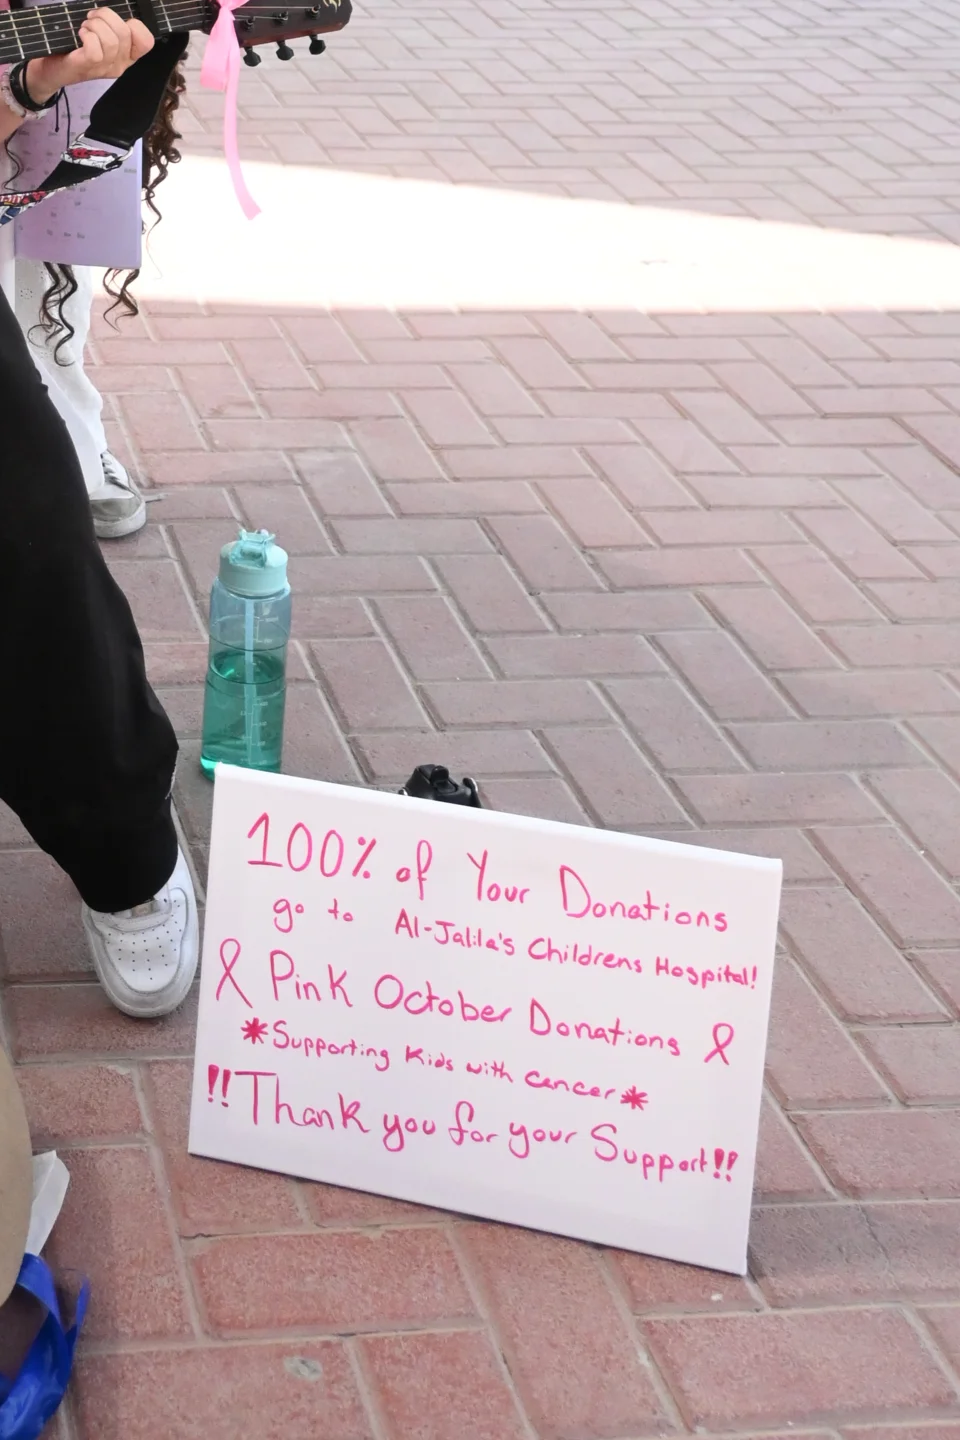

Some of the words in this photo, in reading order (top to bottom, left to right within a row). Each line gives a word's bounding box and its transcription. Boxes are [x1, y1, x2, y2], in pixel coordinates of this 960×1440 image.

[246, 812, 376, 880] 100%
[396, 839, 433, 900] of
[467, 849, 530, 903] Your
[559, 864, 729, 933] Donations
[272, 898, 304, 934] go
[327, 897, 354, 922] to
[394, 908, 515, 957] Al-Jalila's
[527, 936, 642, 973] Childrens
[654, 955, 758, 990] Hospital!
[373, 973, 513, 1023] October
[528, 996, 681, 1057] Donations
[404, 1044, 455, 1072] Kids
[465, 1060, 514, 1084] with
[382, 1112, 437, 1153] you
[447, 1099, 498, 1147] for
[507, 1121, 577, 1160] your
